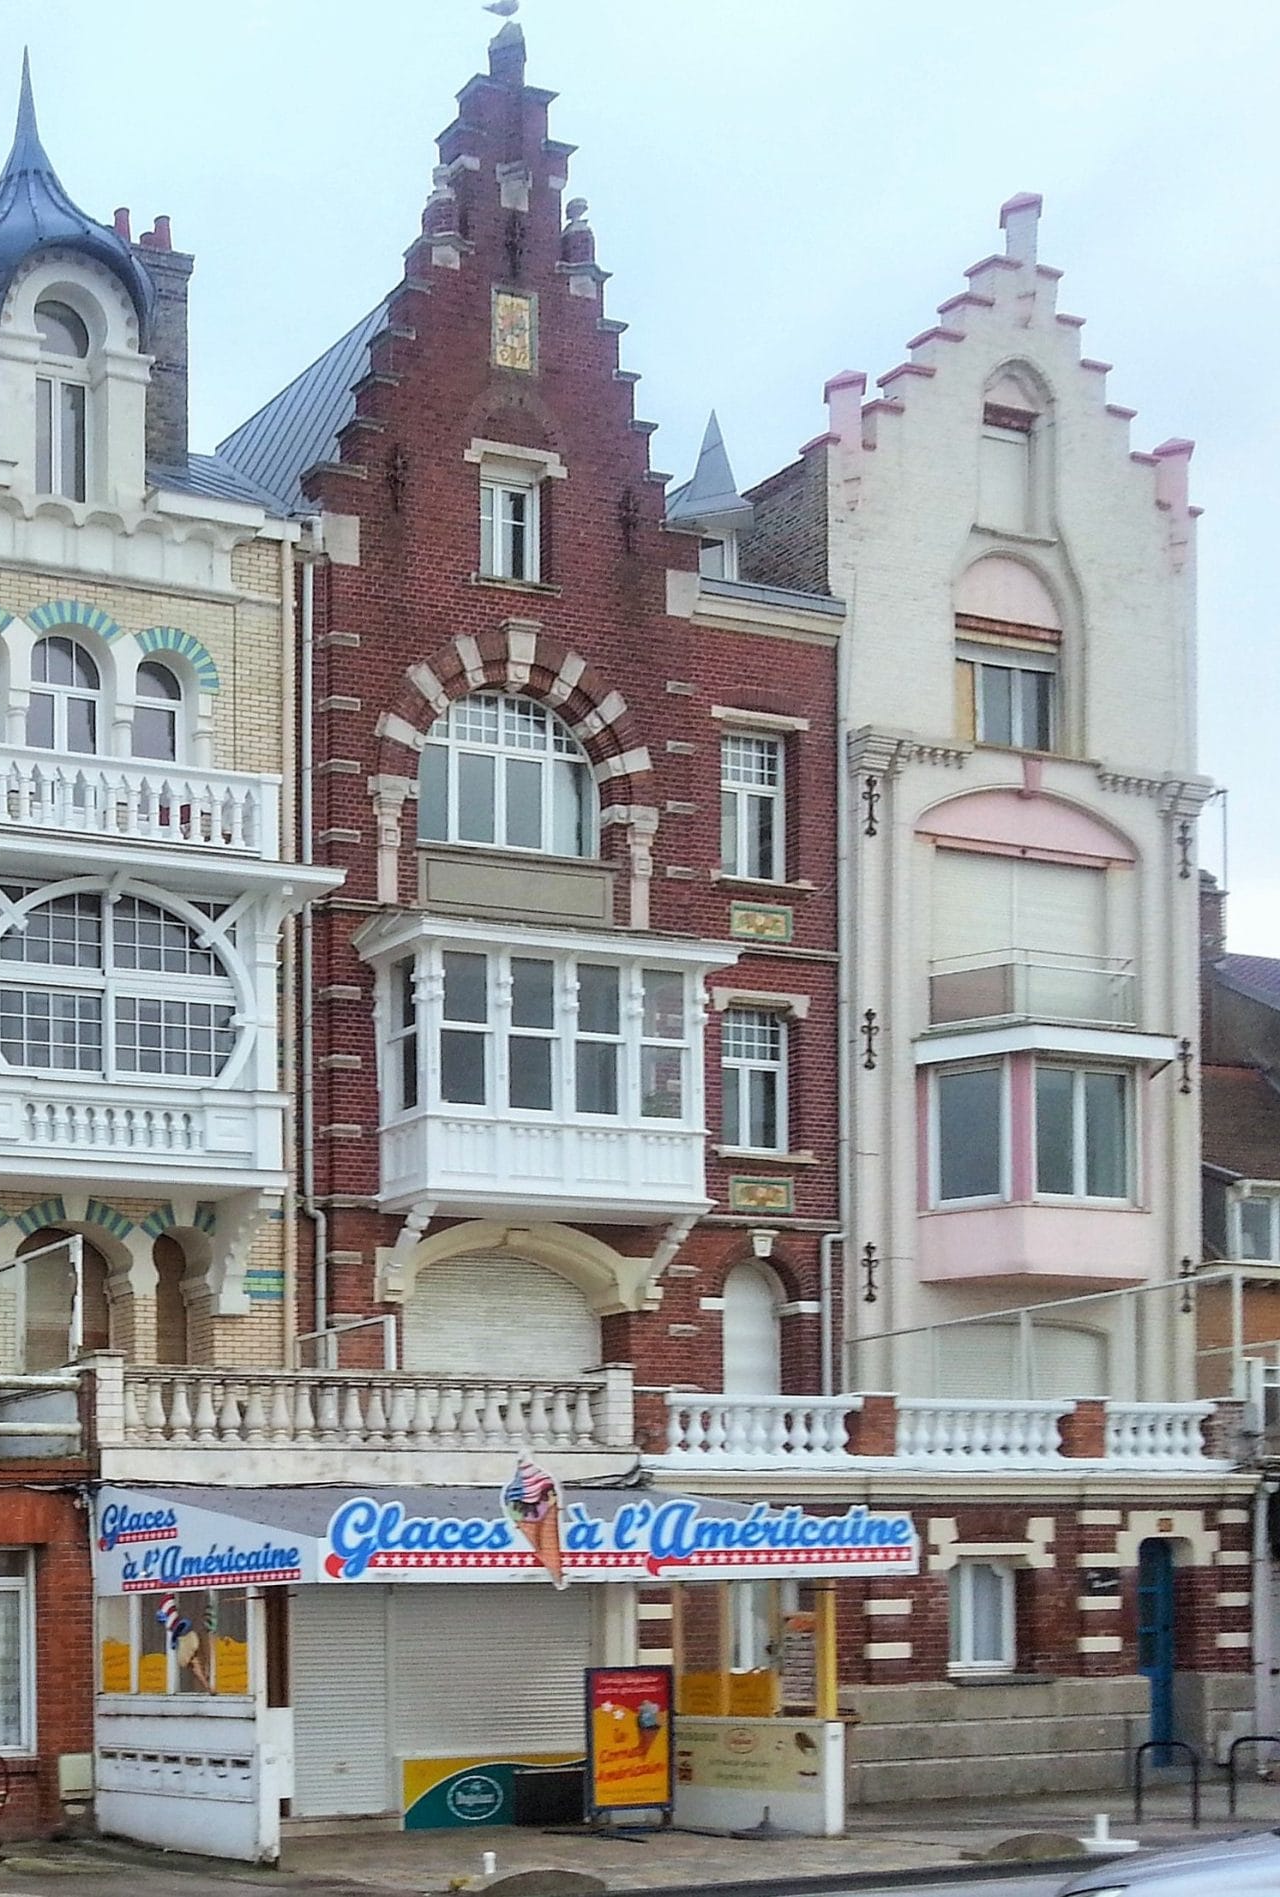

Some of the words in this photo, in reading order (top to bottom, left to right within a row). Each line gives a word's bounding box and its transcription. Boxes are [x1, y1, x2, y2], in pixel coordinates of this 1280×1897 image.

[101, 1503, 178, 1551] Glaces
[330, 1499, 513, 1578] Glaces
[566, 1504, 604, 1551] à
[613, 1501, 911, 1558] l'Américaine
[123, 1551, 138, 1580] à
[143, 1542, 301, 1584] l'Américaine
